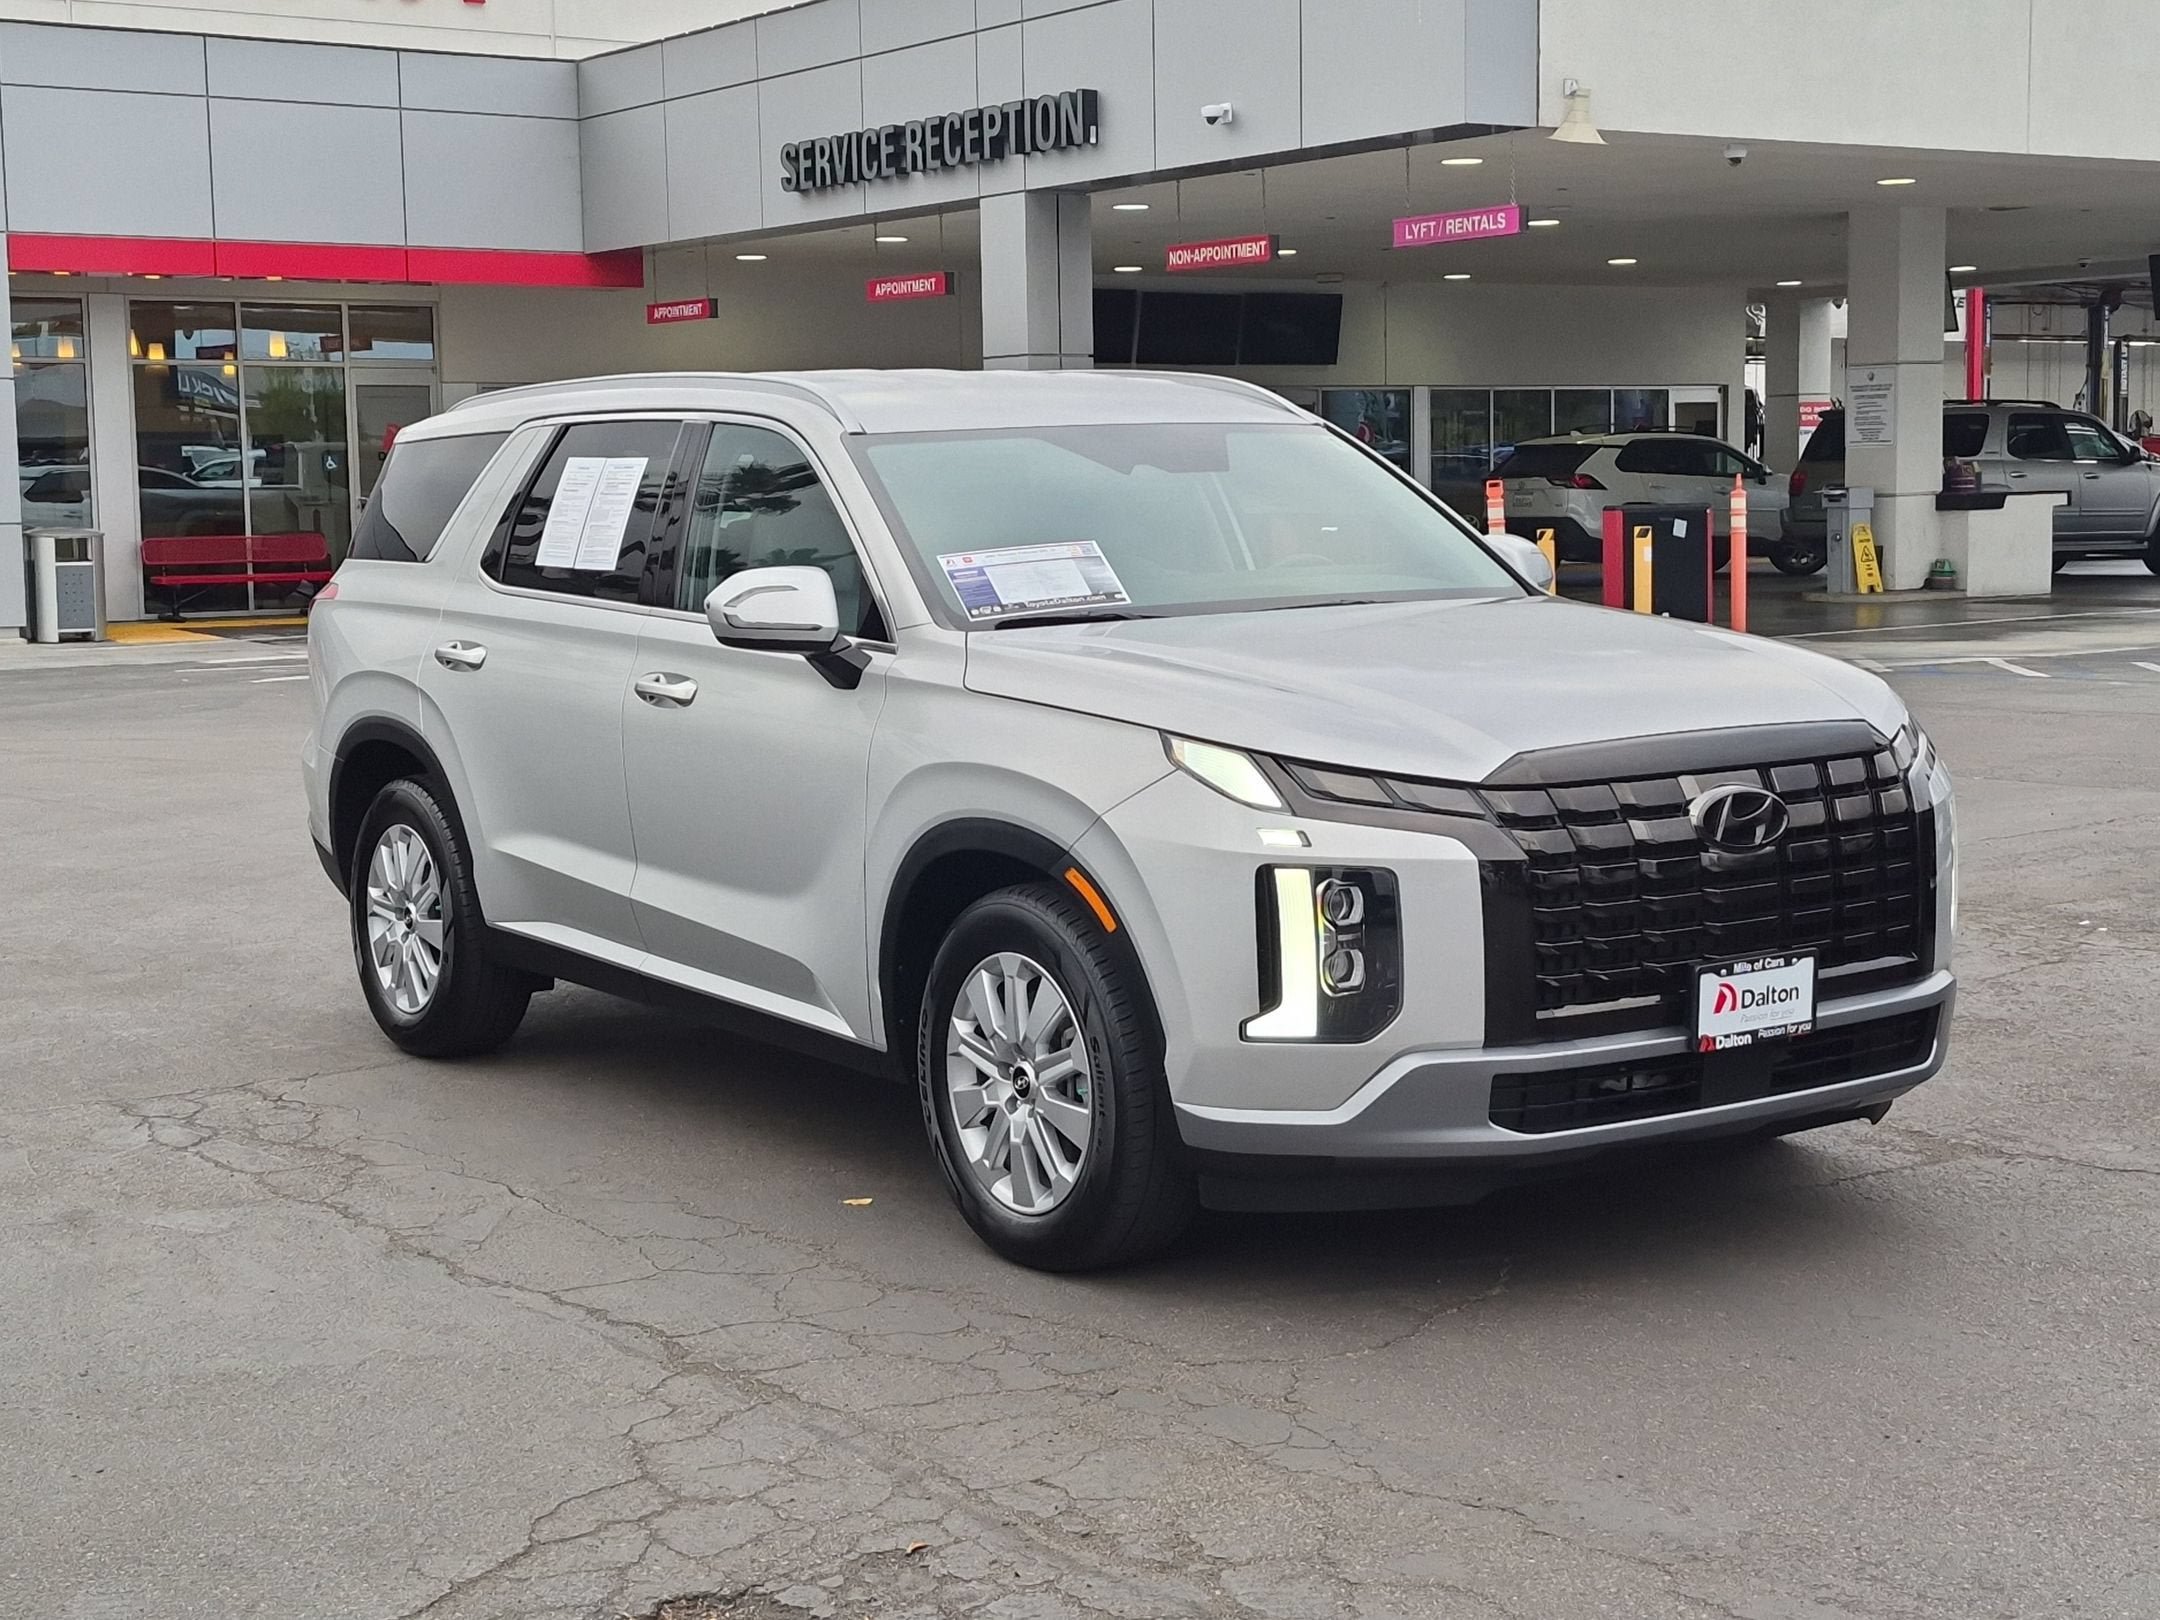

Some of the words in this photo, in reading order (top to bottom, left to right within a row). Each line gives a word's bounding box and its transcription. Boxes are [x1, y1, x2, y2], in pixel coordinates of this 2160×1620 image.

[780, 124, 897, 192] SERVICE
[1405, 221, 1436, 240] LYFT
[1438, 218, 1444, 237] /
[1446, 212, 1506, 235] RENTALS
[1168, 240, 1267, 266] NON-APPOINTMENT
[875, 277, 937, 297] APPOINTMENT
[653, 302, 703, 320] APPOINTMENT
[1741, 985, 1799, 1009] Dalton
[1716, 1033, 1752, 1050] Dalton
